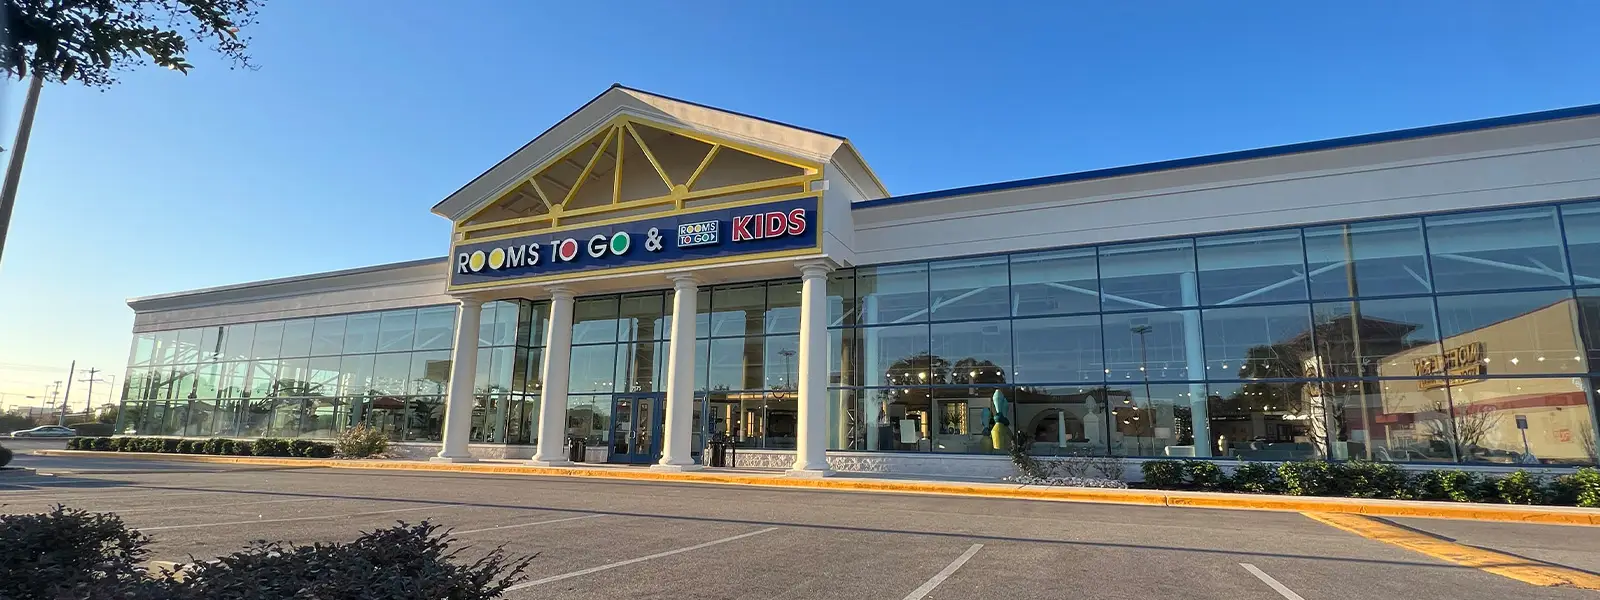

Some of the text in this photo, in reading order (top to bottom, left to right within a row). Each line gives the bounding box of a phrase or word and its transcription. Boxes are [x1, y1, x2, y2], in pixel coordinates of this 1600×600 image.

[680, 222, 716, 235] ROOMS
[732, 208, 806, 241] KIDS
[458, 227, 662, 274] ROOMS TO GO &
[680, 233, 710, 245] TO GO
